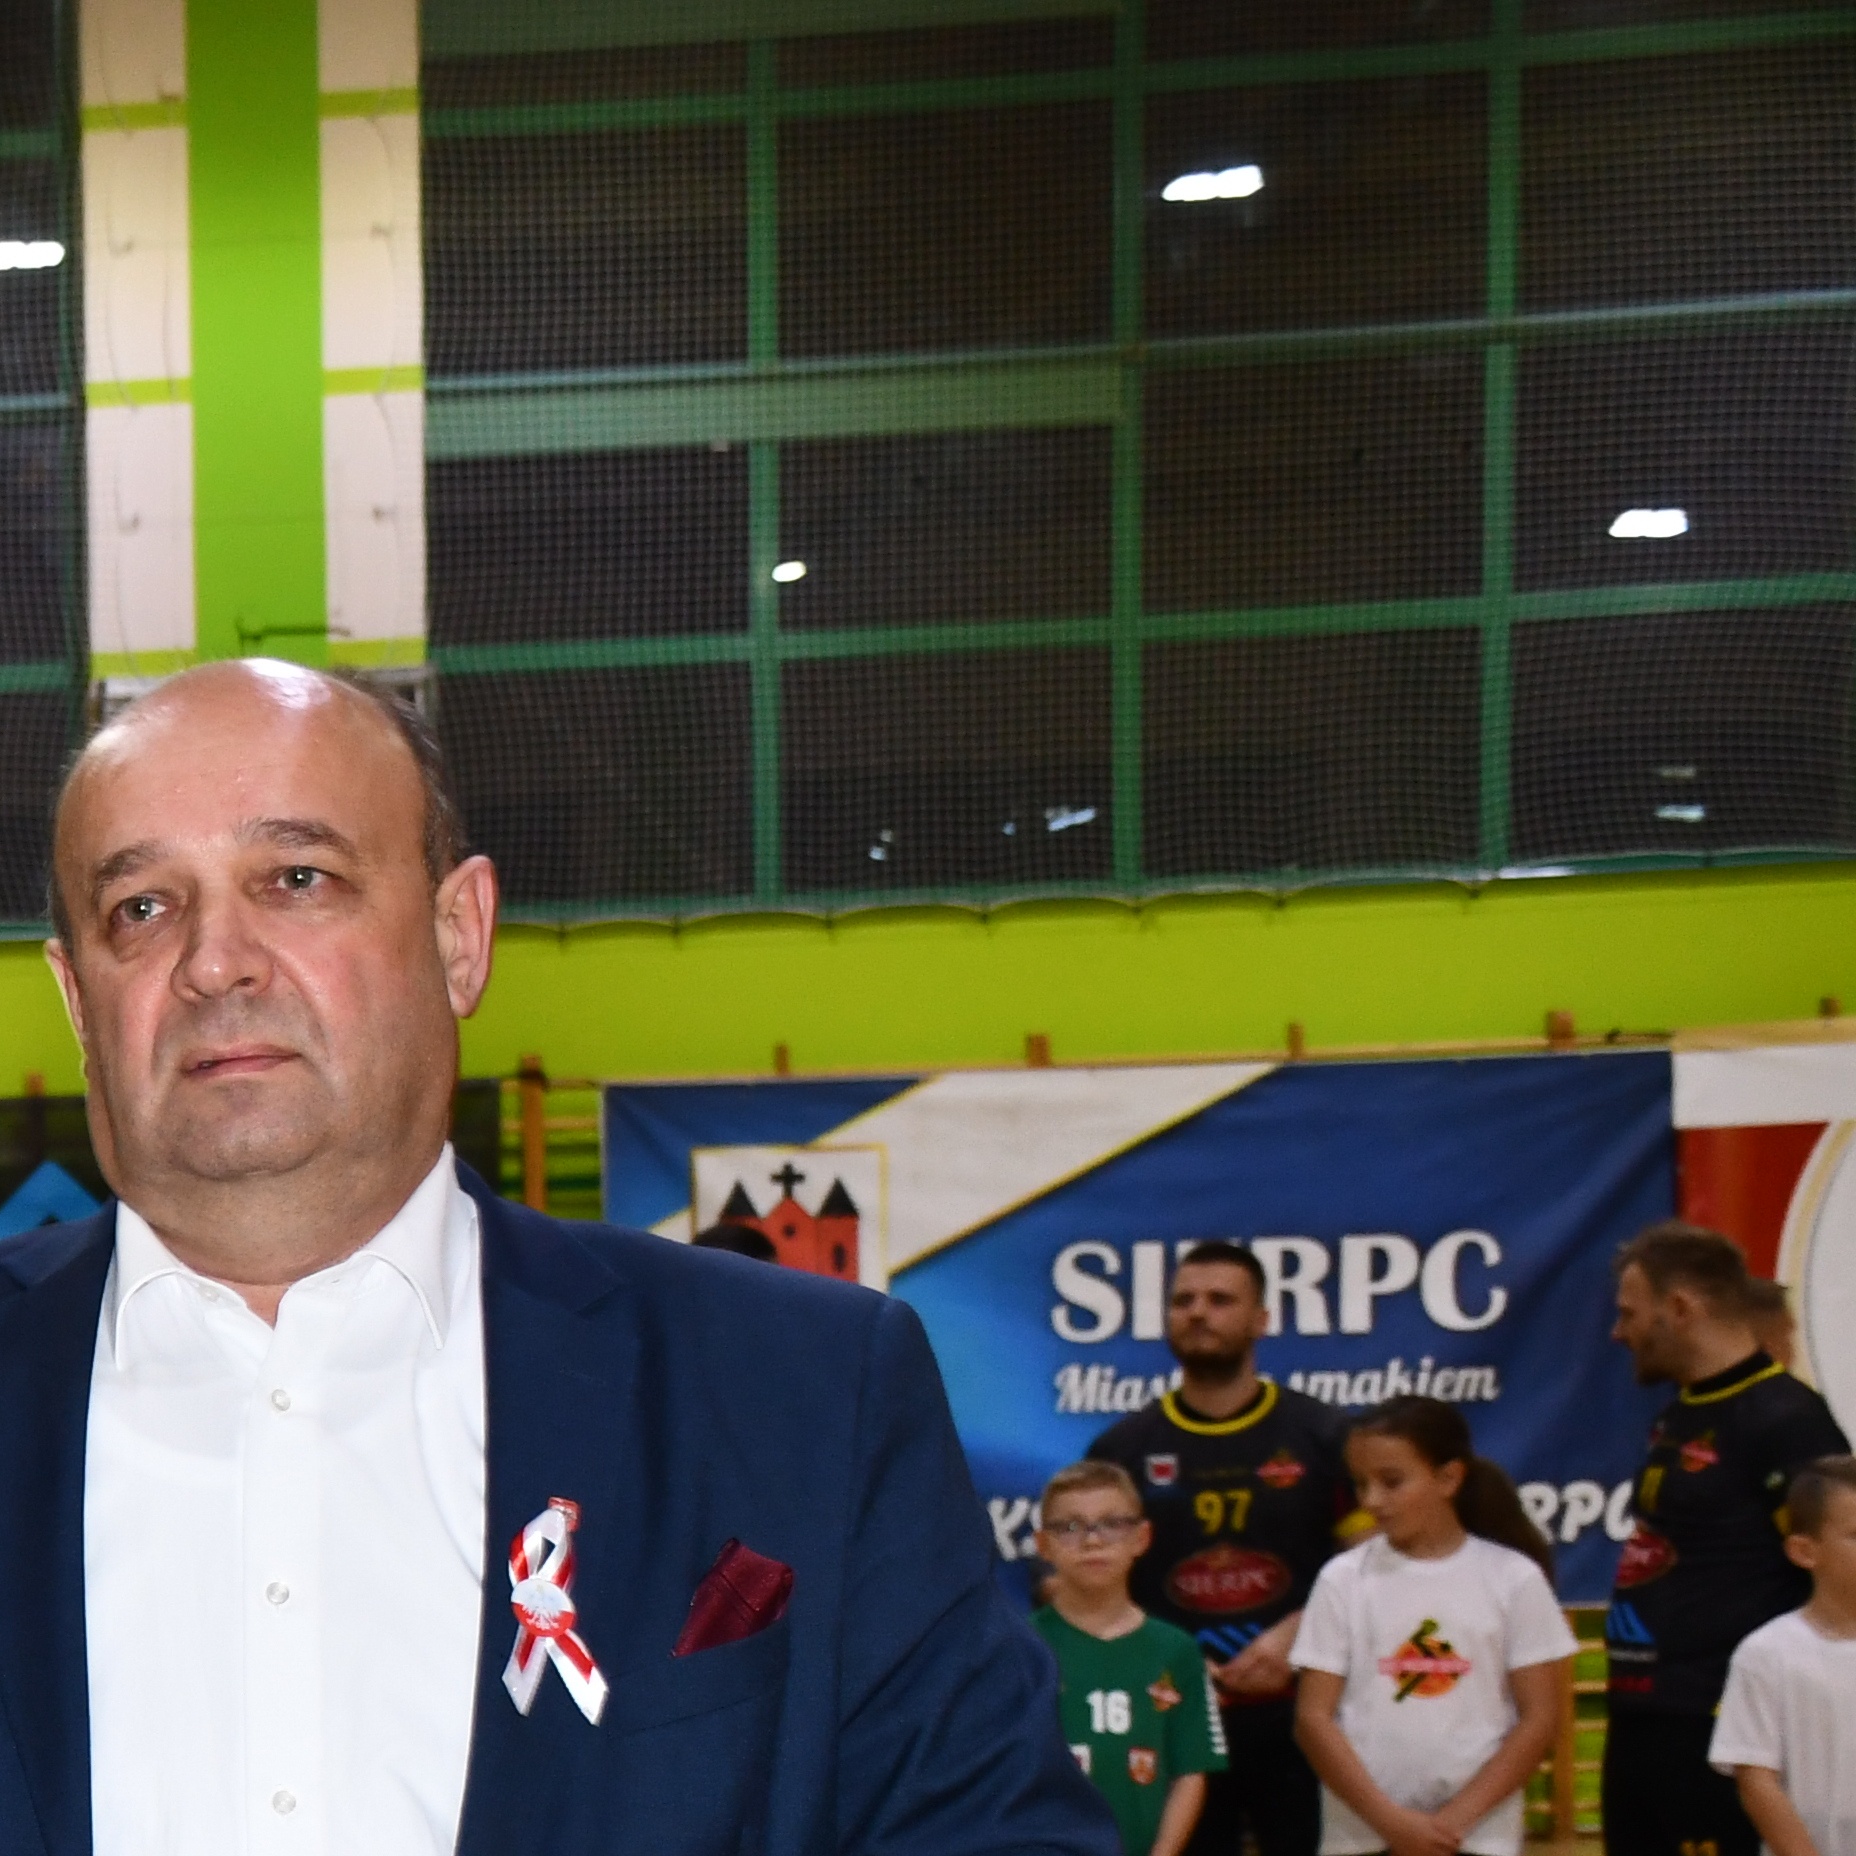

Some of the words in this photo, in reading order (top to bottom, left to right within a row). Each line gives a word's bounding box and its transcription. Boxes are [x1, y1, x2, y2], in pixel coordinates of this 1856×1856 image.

[1051, 1228, 1509, 1344] SIRPC
[1193, 1489, 1253, 1534] 97
[1086, 1689, 1131, 1734] 16
